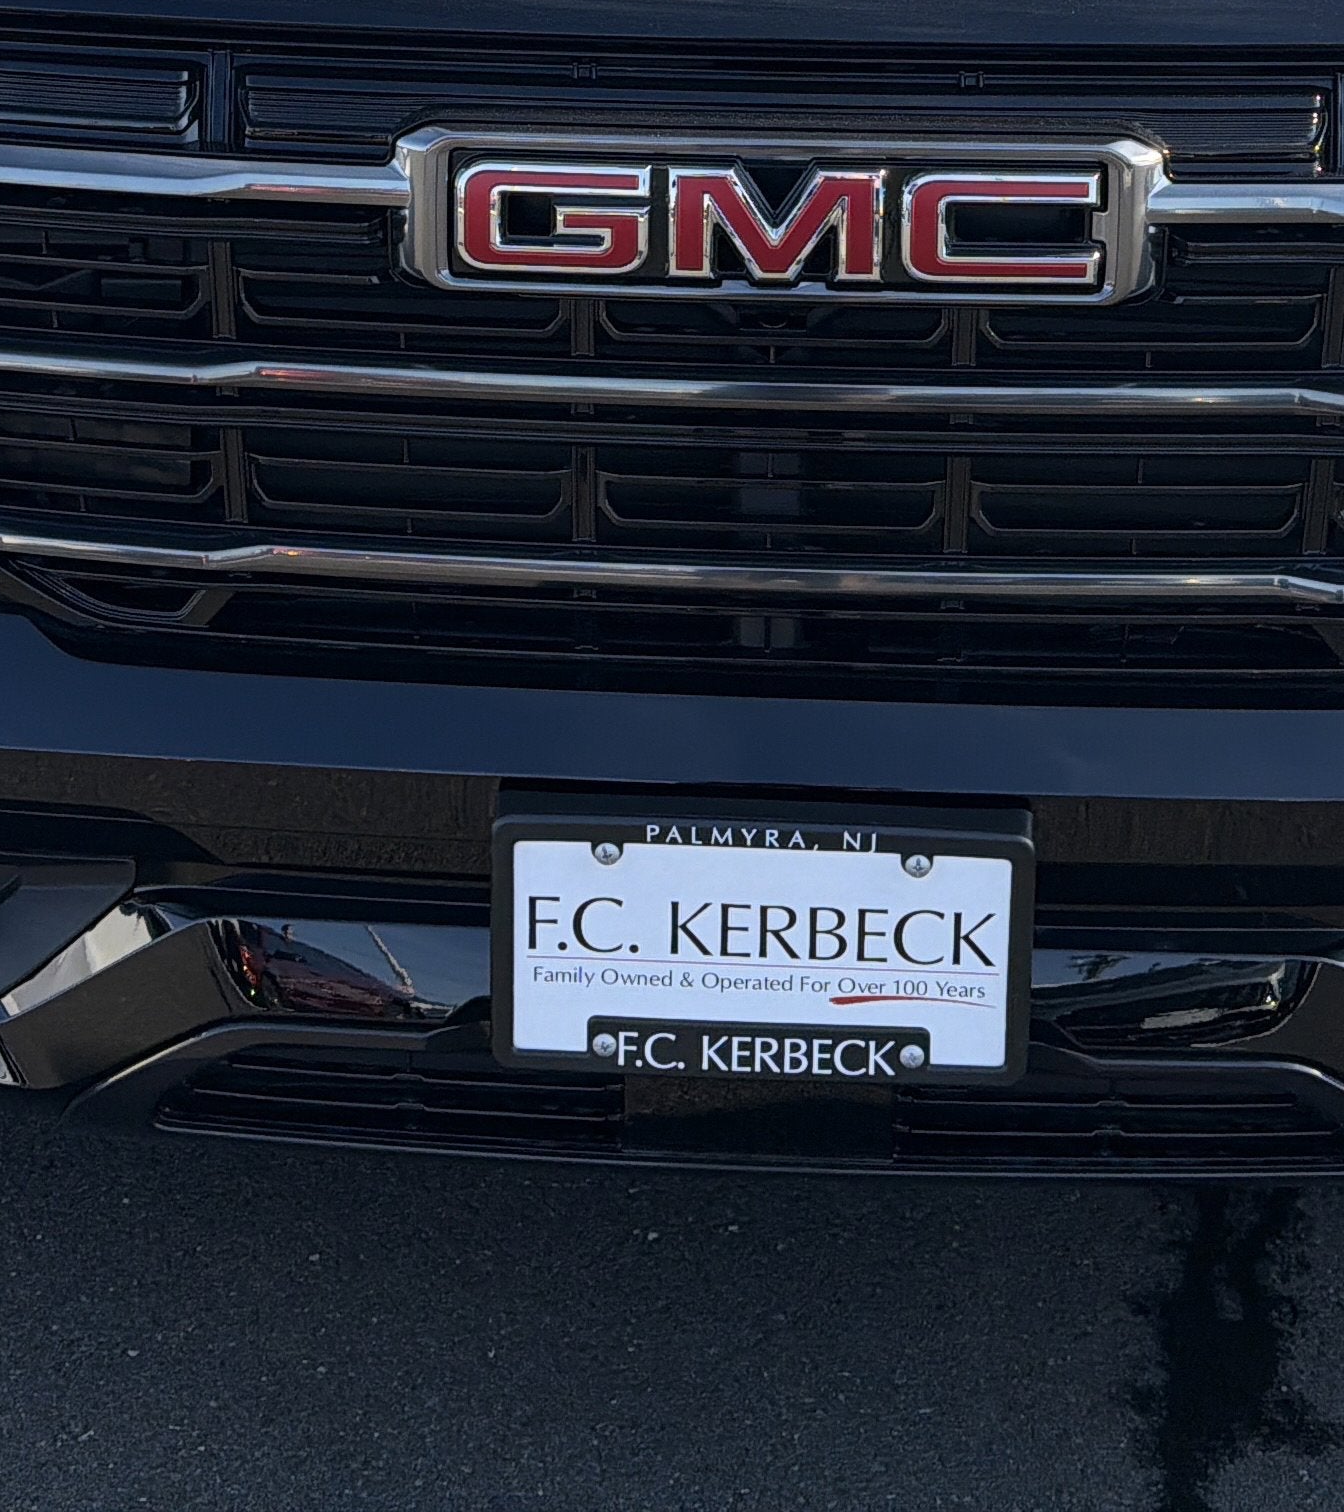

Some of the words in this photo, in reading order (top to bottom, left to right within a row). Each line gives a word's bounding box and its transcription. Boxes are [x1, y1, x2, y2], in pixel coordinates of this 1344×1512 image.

[457, 161, 1103, 285] GMC
[645, 824, 820, 851] PALMYRA,
[843, 831, 879, 854] NJ
[527, 896, 640, 954] F.C.
[669, 901, 997, 968] KERBECK
[533, 966, 595, 988] Family
[601, 968, 673, 989] Owned
[679, 972, 695, 989] &
[702, 972, 794, 996] Operated
[800, 977, 830, 994] For
[838, 977, 885, 996] Over
[893, 979, 928, 997] 100
[935, 980, 986, 999] Years
[617, 1032, 685, 1071] F.C.
[701, 1037, 896, 1077] KERBECK
